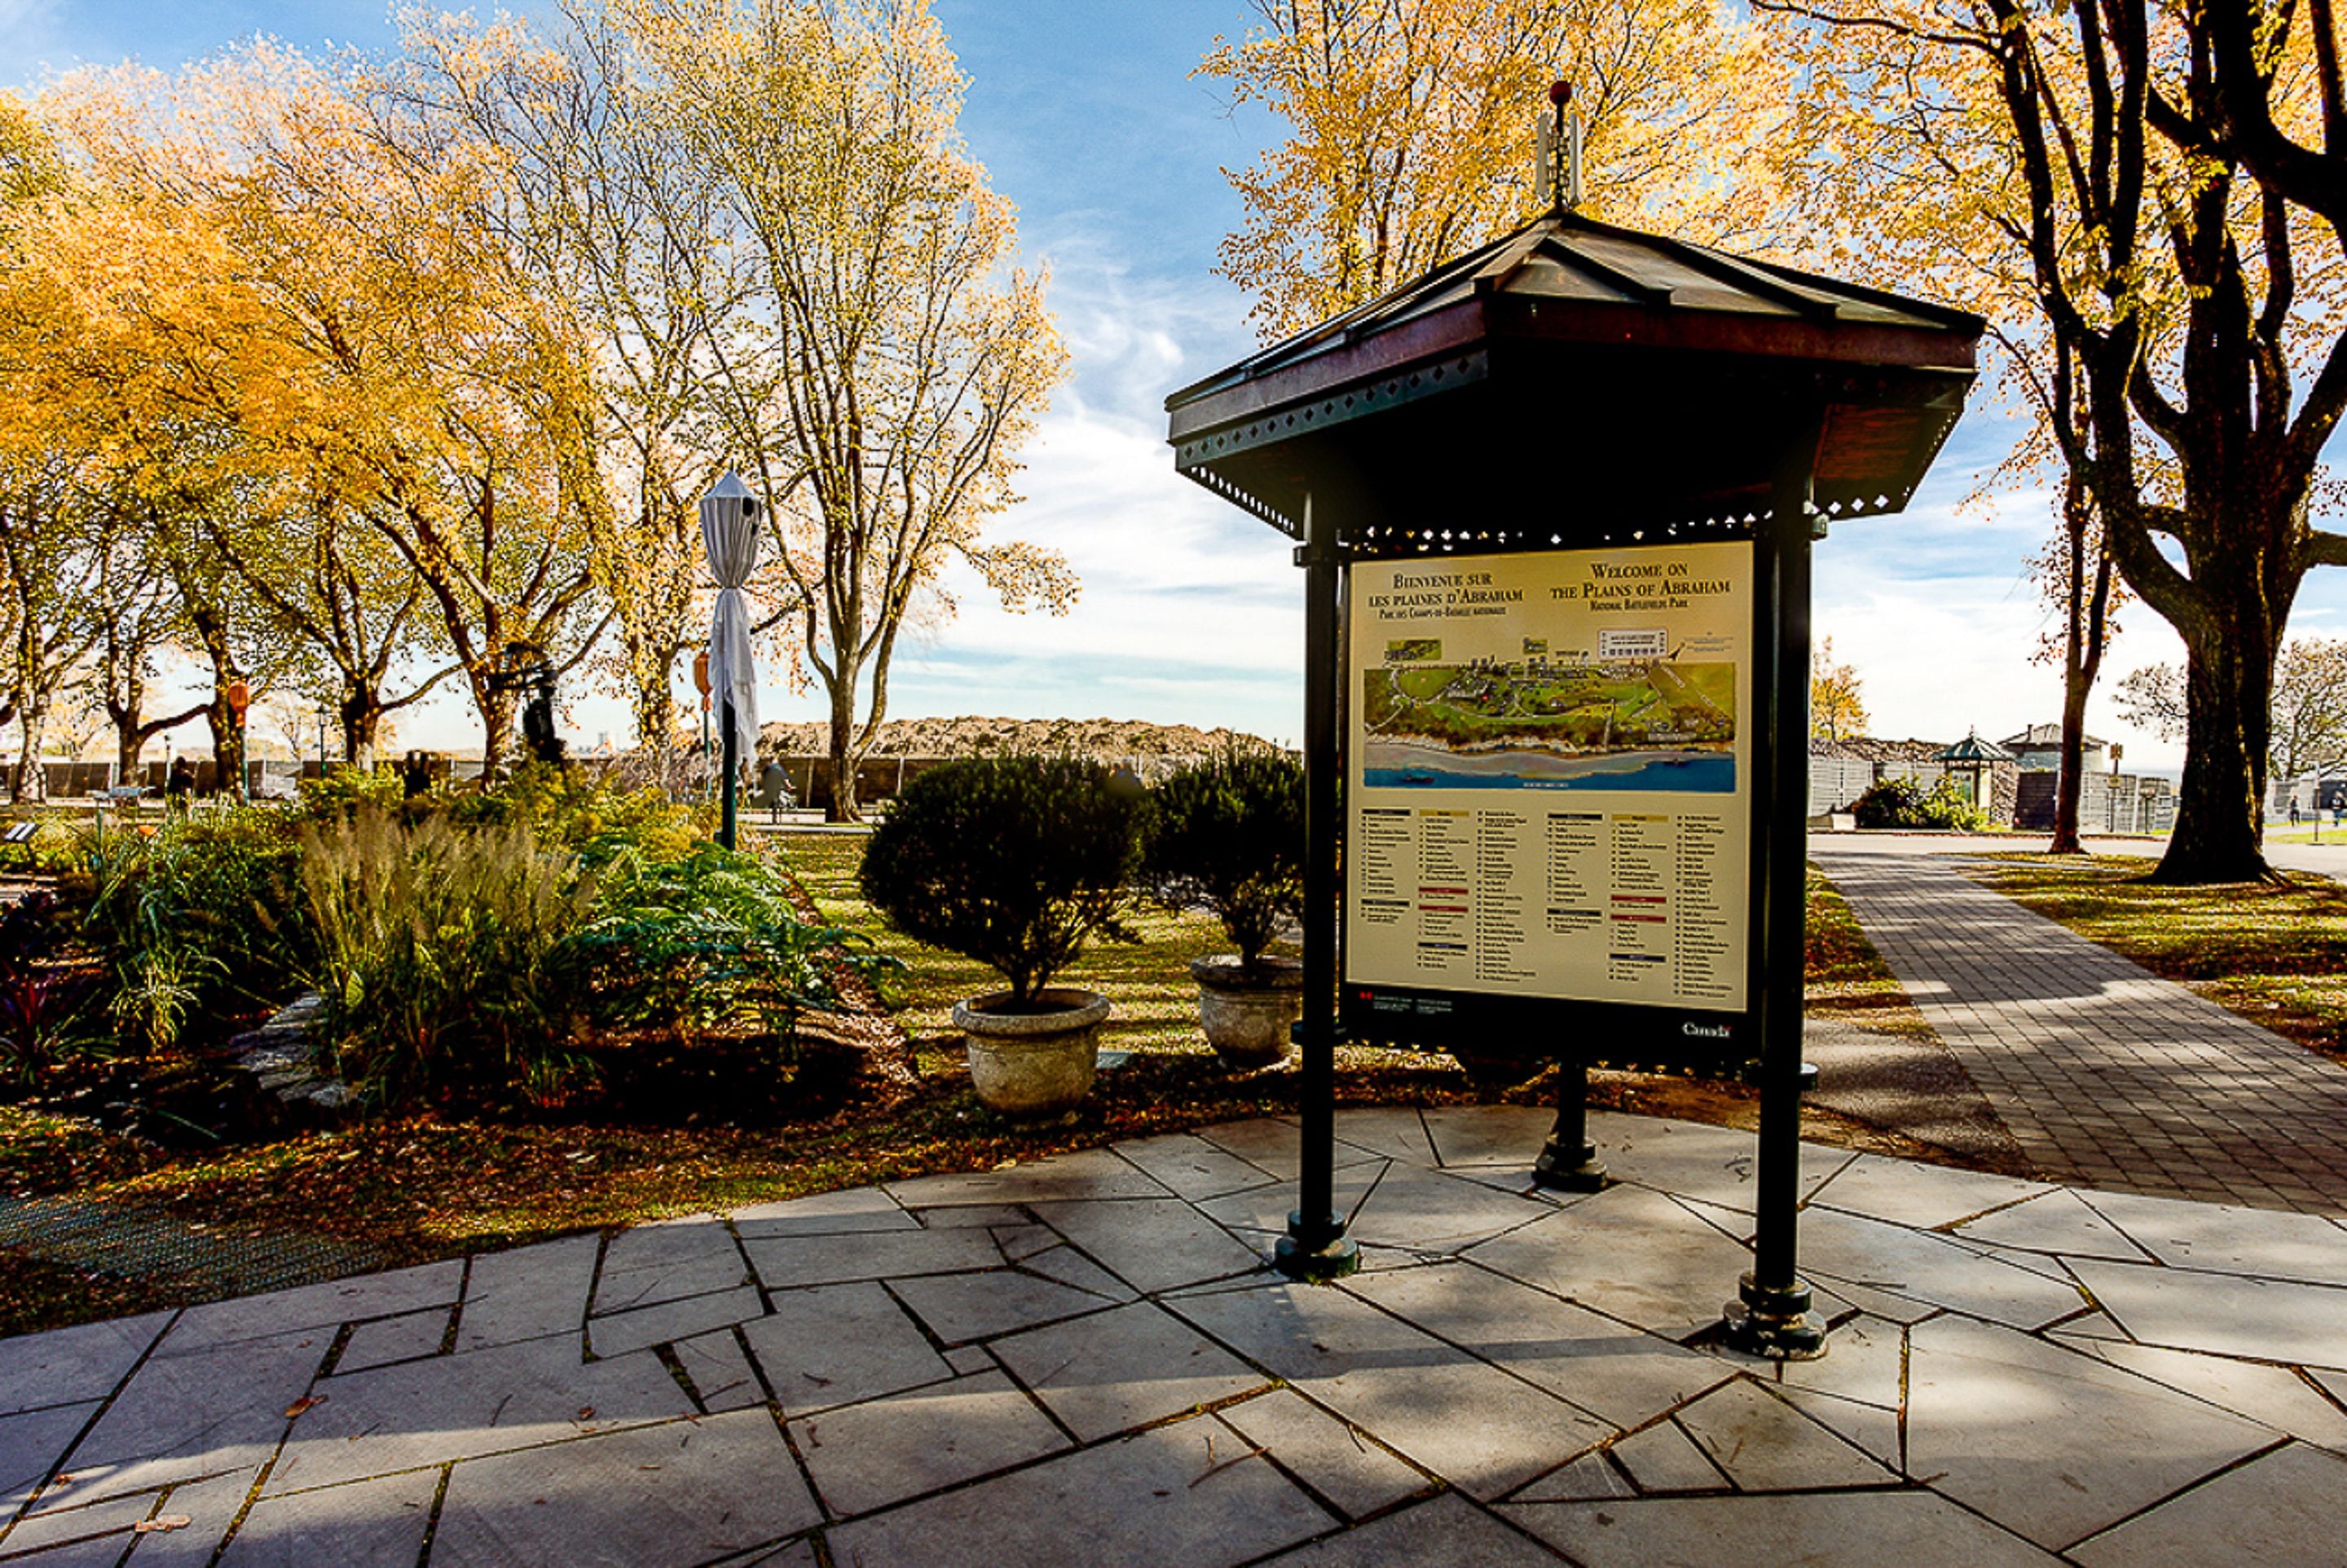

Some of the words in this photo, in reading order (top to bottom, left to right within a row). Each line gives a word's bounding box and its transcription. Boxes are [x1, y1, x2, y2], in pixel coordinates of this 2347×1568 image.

[1590, 562, 1662, 579] WELCOME
[1667, 562, 1688, 576] ON
[1393, 573, 1464, 589] BIENVENUE
[1467, 573, 1493, 585] SUR
[1550, 586, 1579, 599] THE
[1582, 582, 1632, 598] PLAINS
[1636, 584, 1655, 597] OF
[1659, 579, 1731, 595] ABRAHAM
[1368, 596, 1389, 607] LES
[1393, 593, 1442, 606] PLAINES
[1447, 588, 1523, 604] D'ABRAHAM
[1681, 1021, 1731, 1038] Canada
